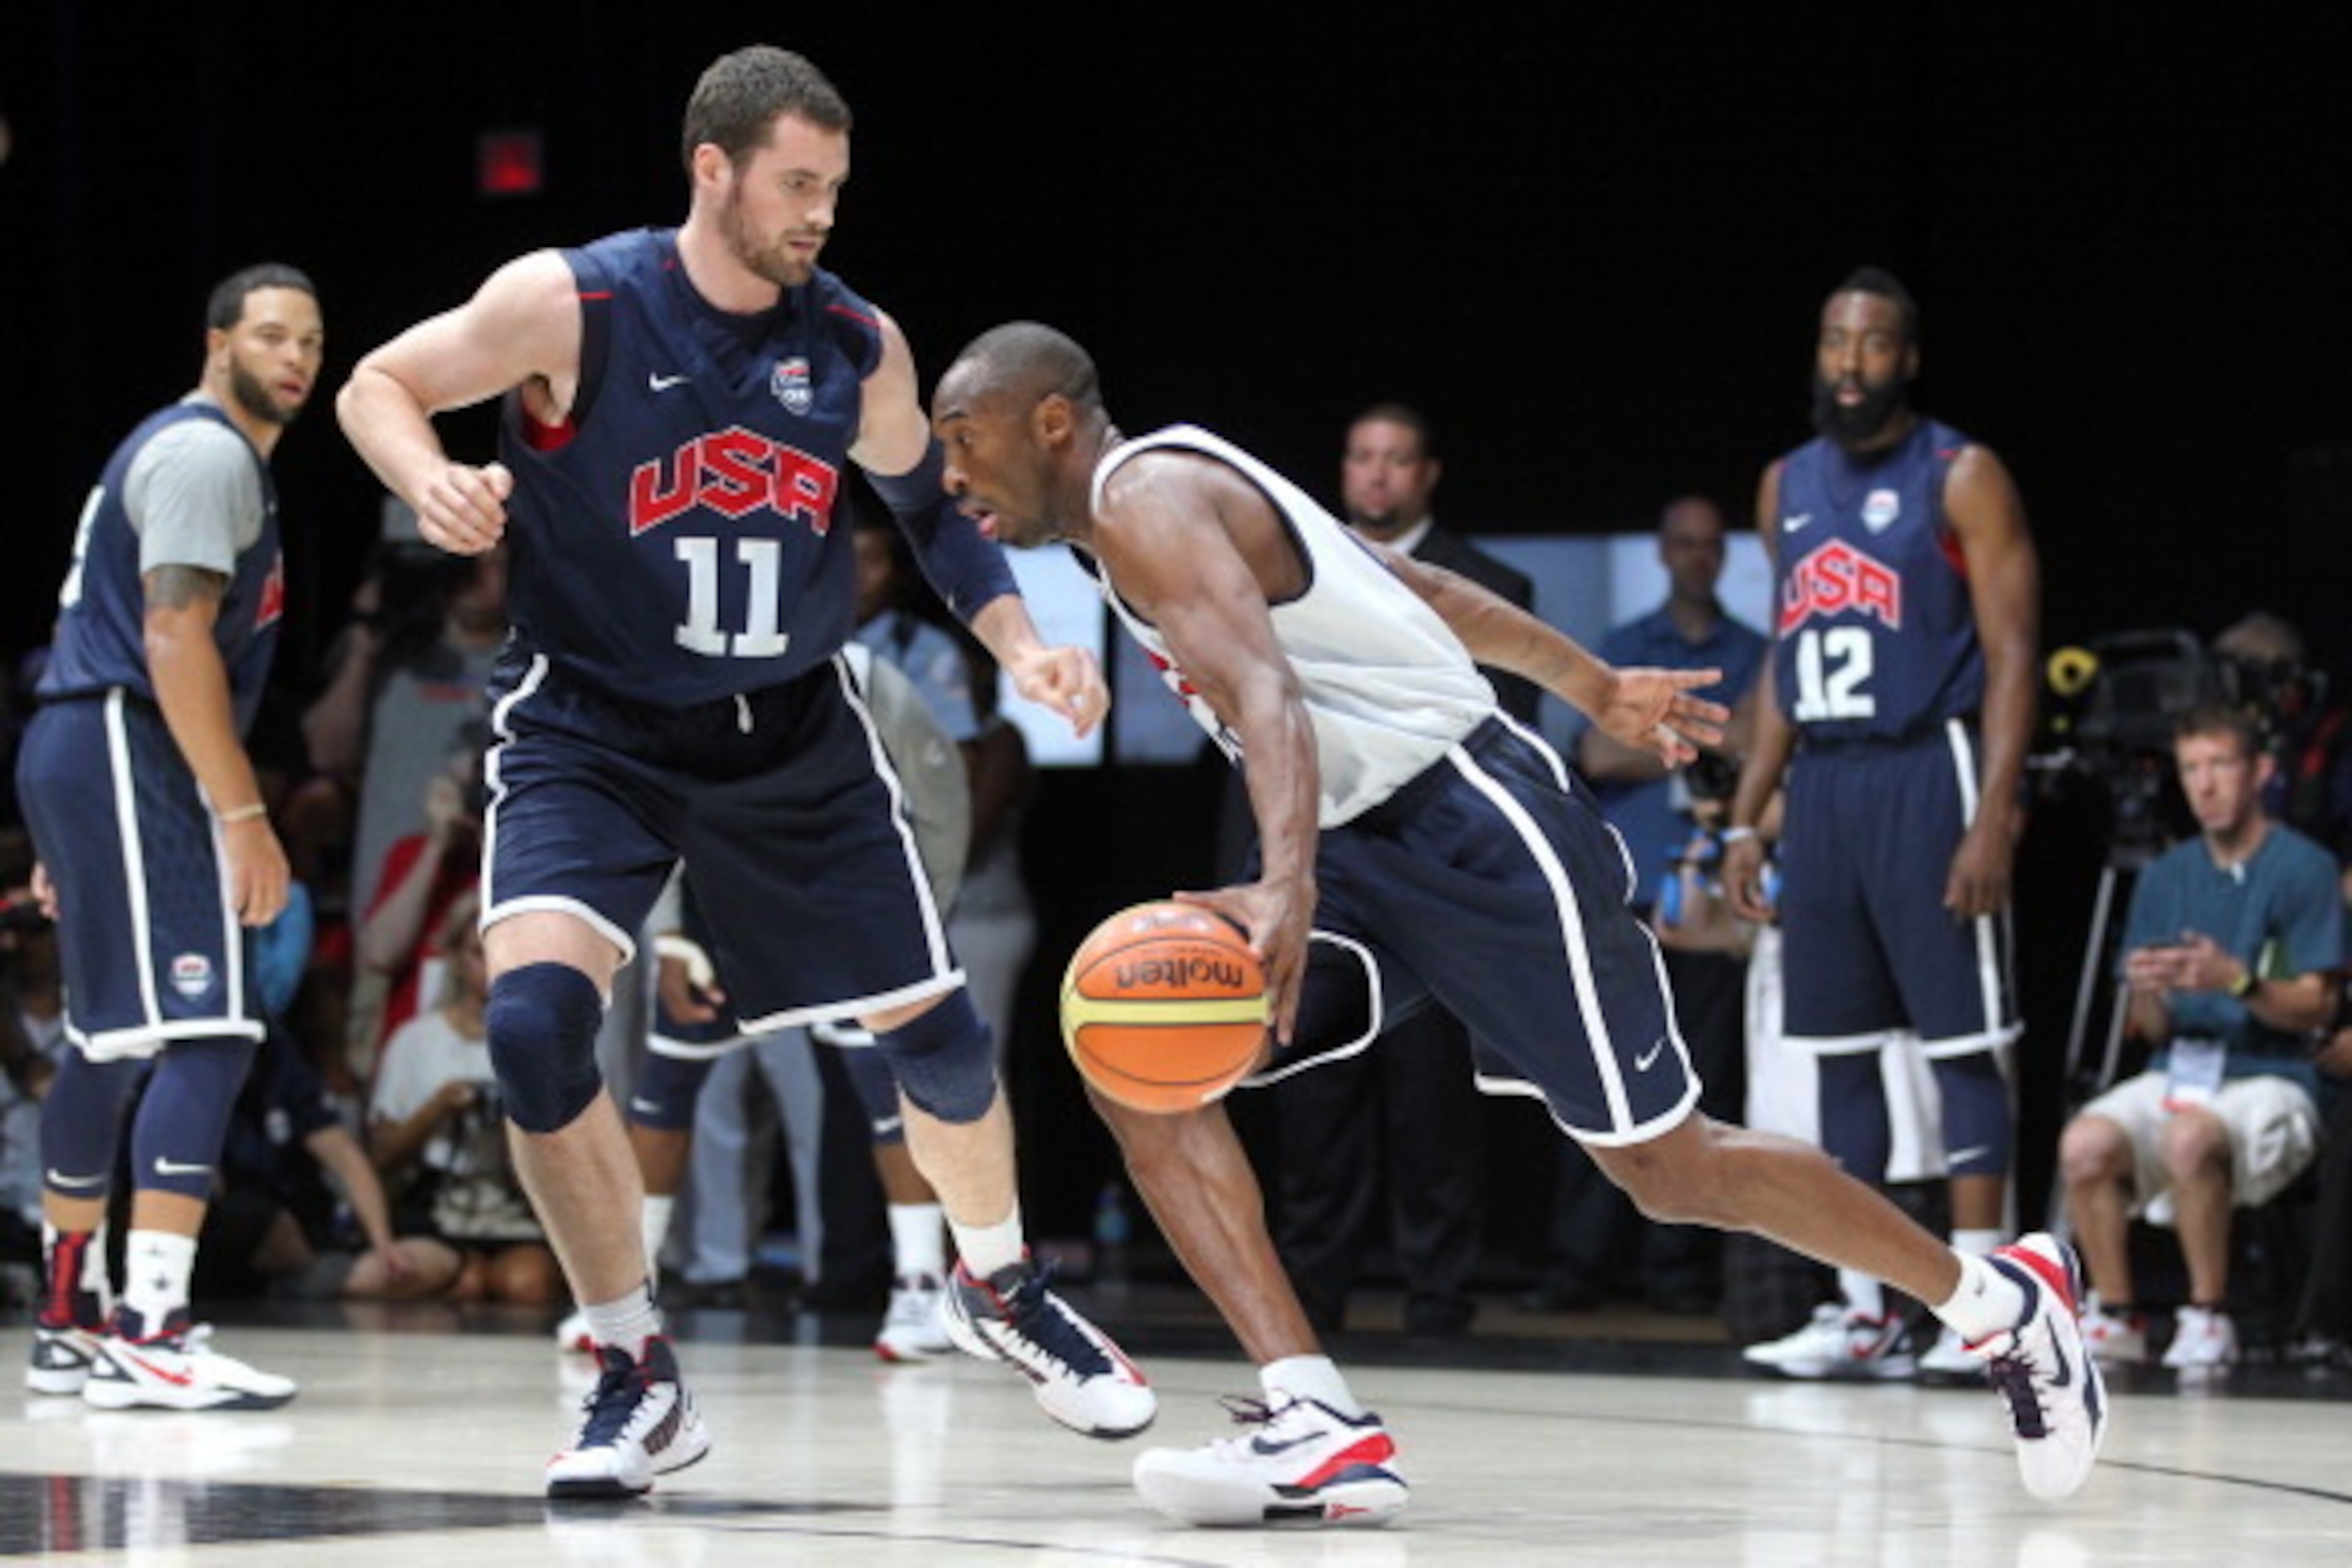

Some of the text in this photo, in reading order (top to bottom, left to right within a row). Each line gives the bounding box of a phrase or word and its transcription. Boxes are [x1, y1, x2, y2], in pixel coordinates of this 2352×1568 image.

[629, 424, 839, 537] USA
[674, 536, 790, 658] 11
[1779, 538, 1901, 641] USA
[1794, 625, 1875, 722] 12
[1116, 959, 1244, 989] molten
